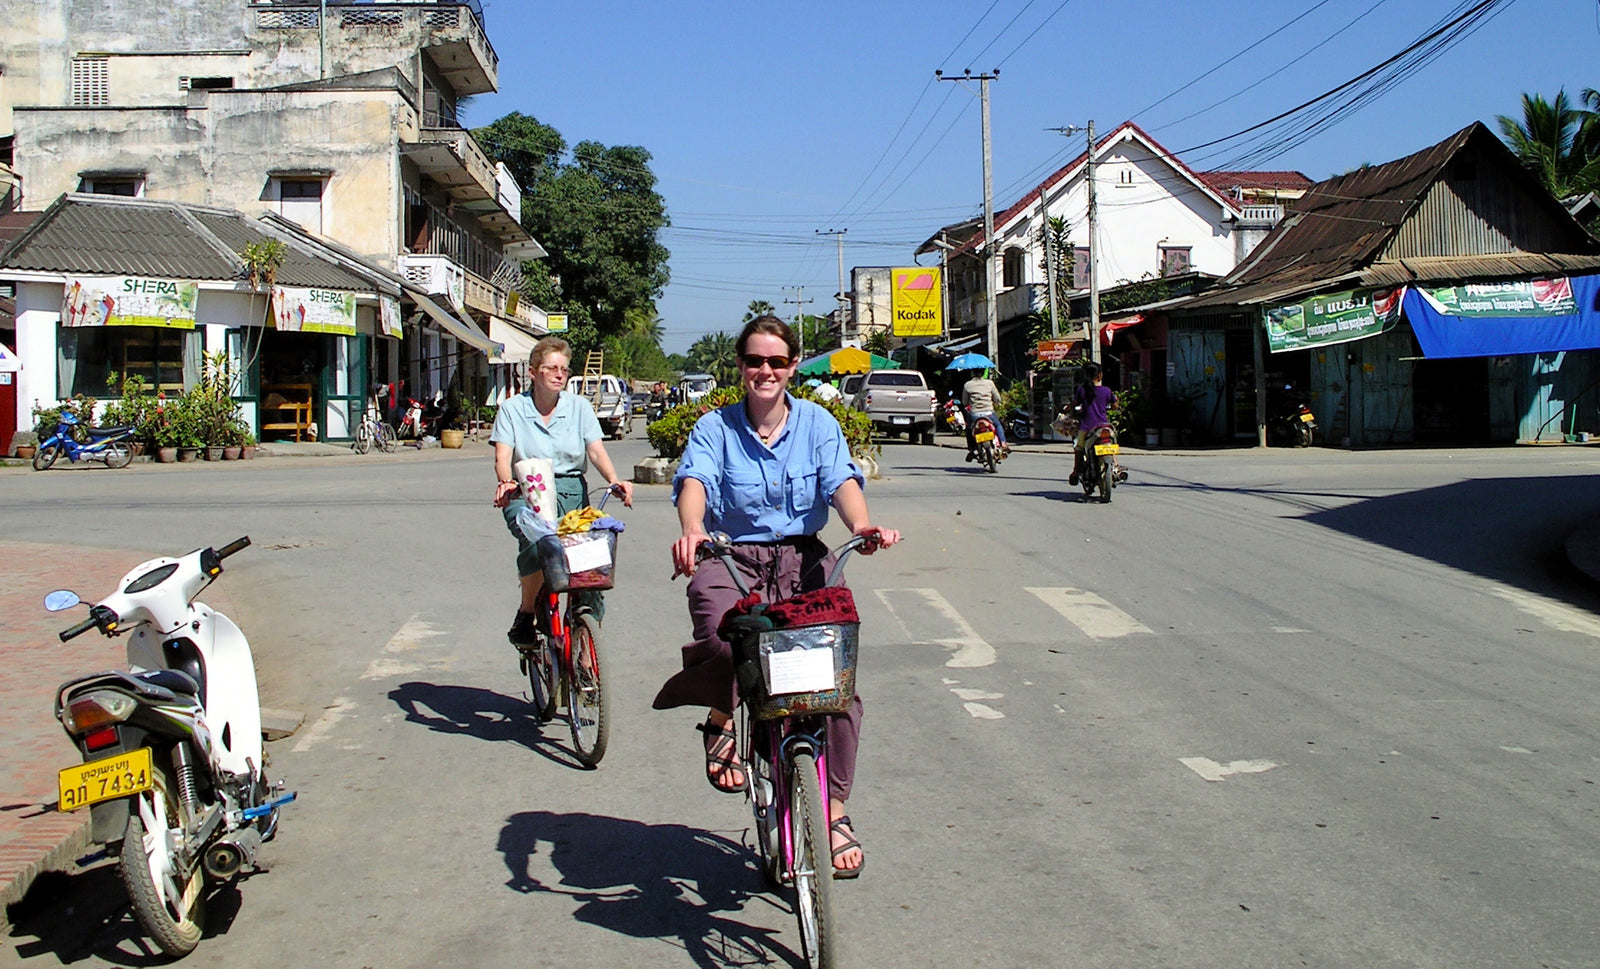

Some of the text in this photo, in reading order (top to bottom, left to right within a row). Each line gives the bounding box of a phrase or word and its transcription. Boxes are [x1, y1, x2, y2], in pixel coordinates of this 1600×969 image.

[123, 279, 178, 295] SHERA
[309, 289, 344, 304] SHERA
[897, 309, 936, 320] Kodak
[98, 769, 146, 796] 7434
